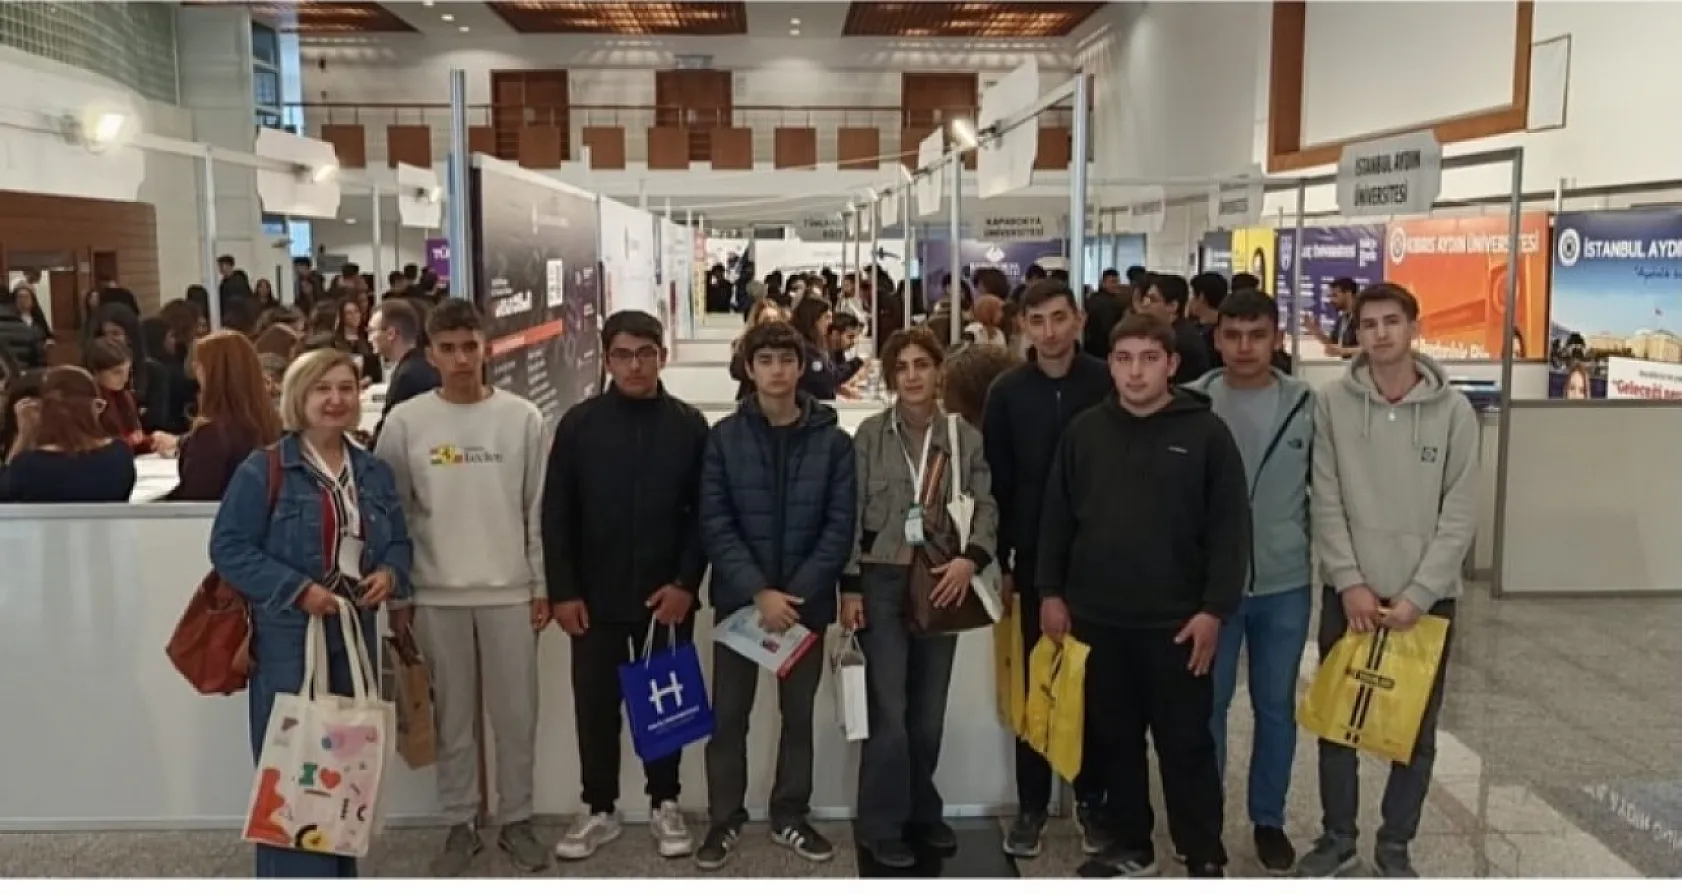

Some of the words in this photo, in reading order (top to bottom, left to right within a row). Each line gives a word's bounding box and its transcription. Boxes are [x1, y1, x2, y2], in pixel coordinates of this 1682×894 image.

[1583, 236, 1645, 258] İSTANBUL
[1647, 238, 1682, 258] AYDI
[648, 671, 683, 715] H
